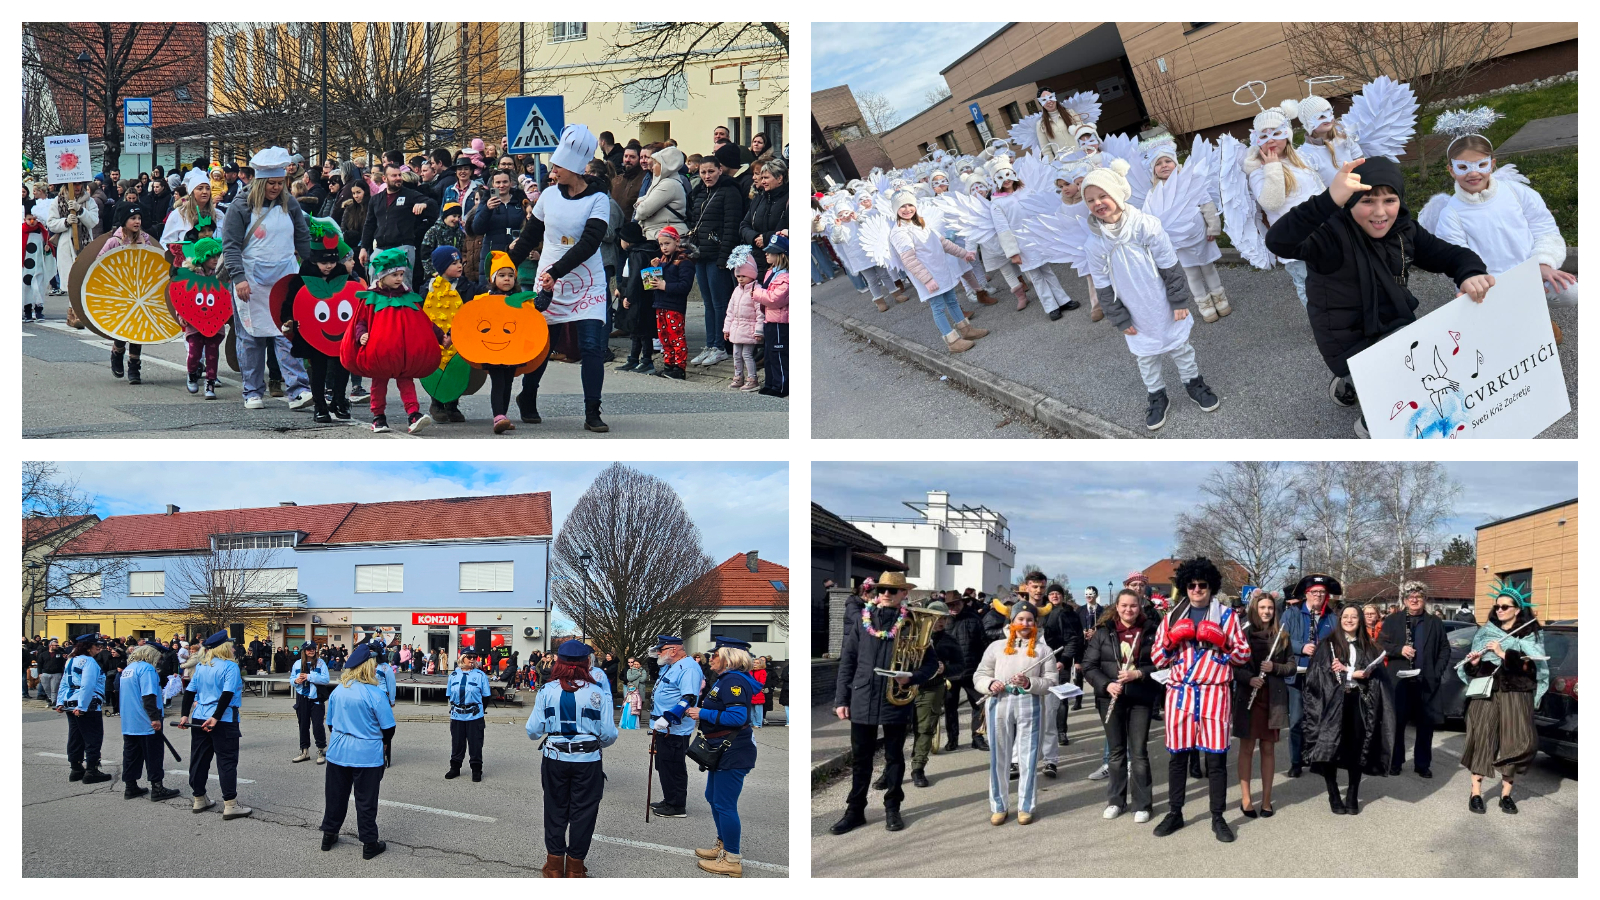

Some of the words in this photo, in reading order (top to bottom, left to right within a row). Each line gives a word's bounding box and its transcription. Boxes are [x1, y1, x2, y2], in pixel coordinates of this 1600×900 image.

[1464, 342, 1555, 410] CVRKUTIĆI
[1471, 410, 1489, 429] Sveti
[1489, 402, 1503, 417] Križ
[1504, 385, 1531, 408] Začretje
[418, 615, 459, 624] KONZUM
